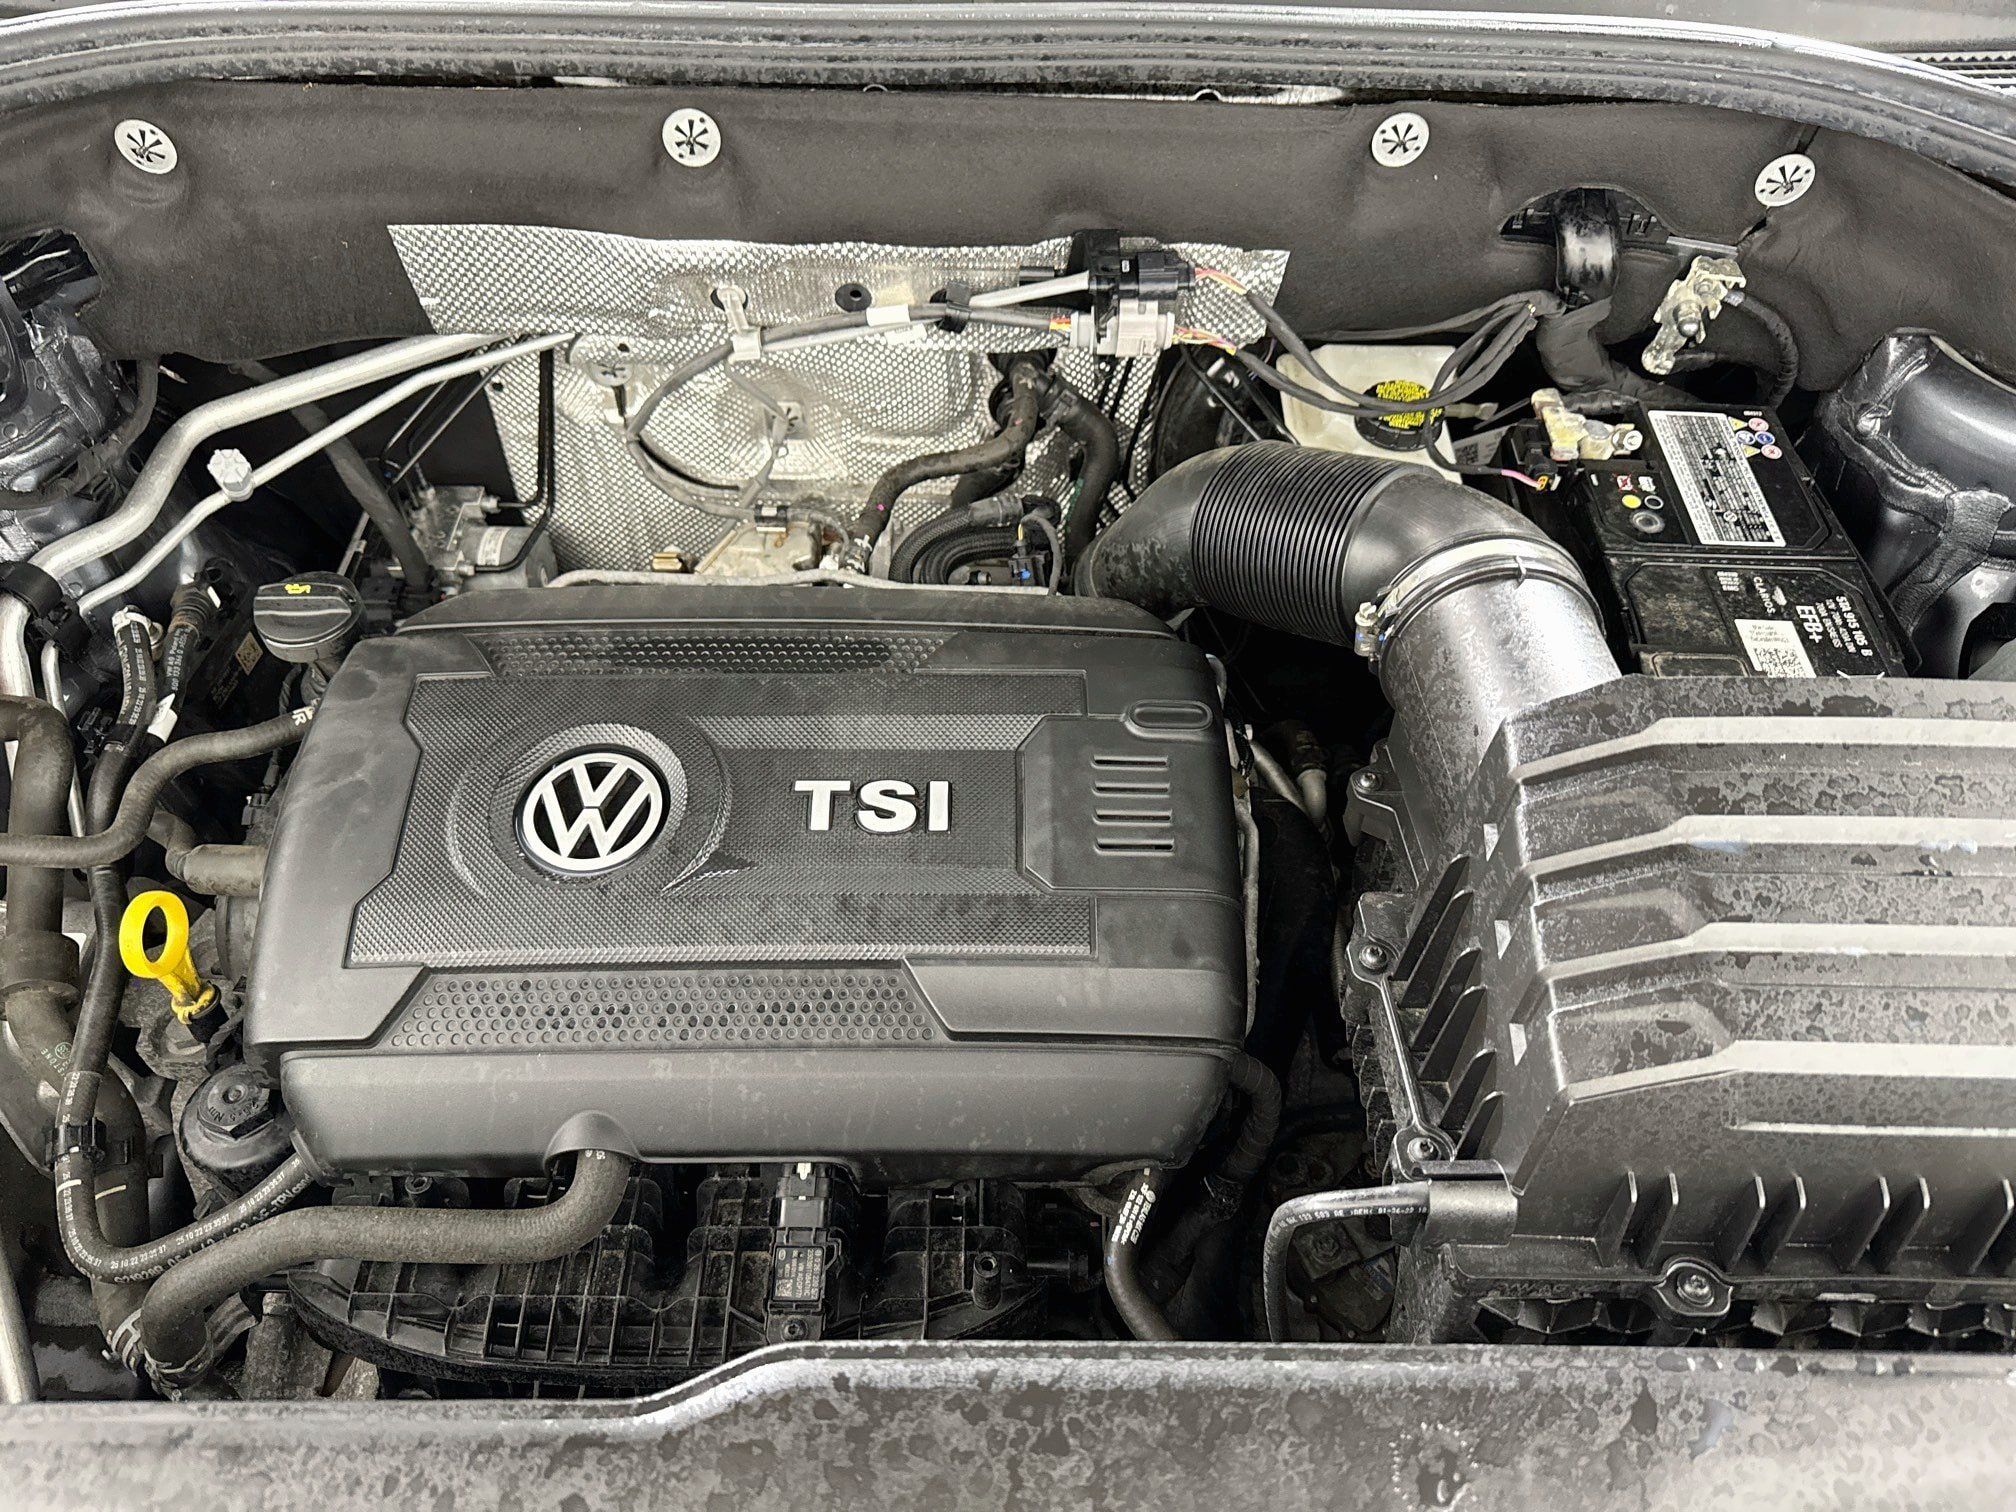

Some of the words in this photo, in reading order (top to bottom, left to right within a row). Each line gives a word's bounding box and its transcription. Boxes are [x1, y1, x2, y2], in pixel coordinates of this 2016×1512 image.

[1753, 576, 1776, 615] CLARIOS
[1796, 605, 1824, 643] EFB+
[1843, 612, 1859, 629] 915
[1852, 629, 1868, 646] 105
[1861, 648, 1873, 657] B
[793, 779, 953, 833] TSI
